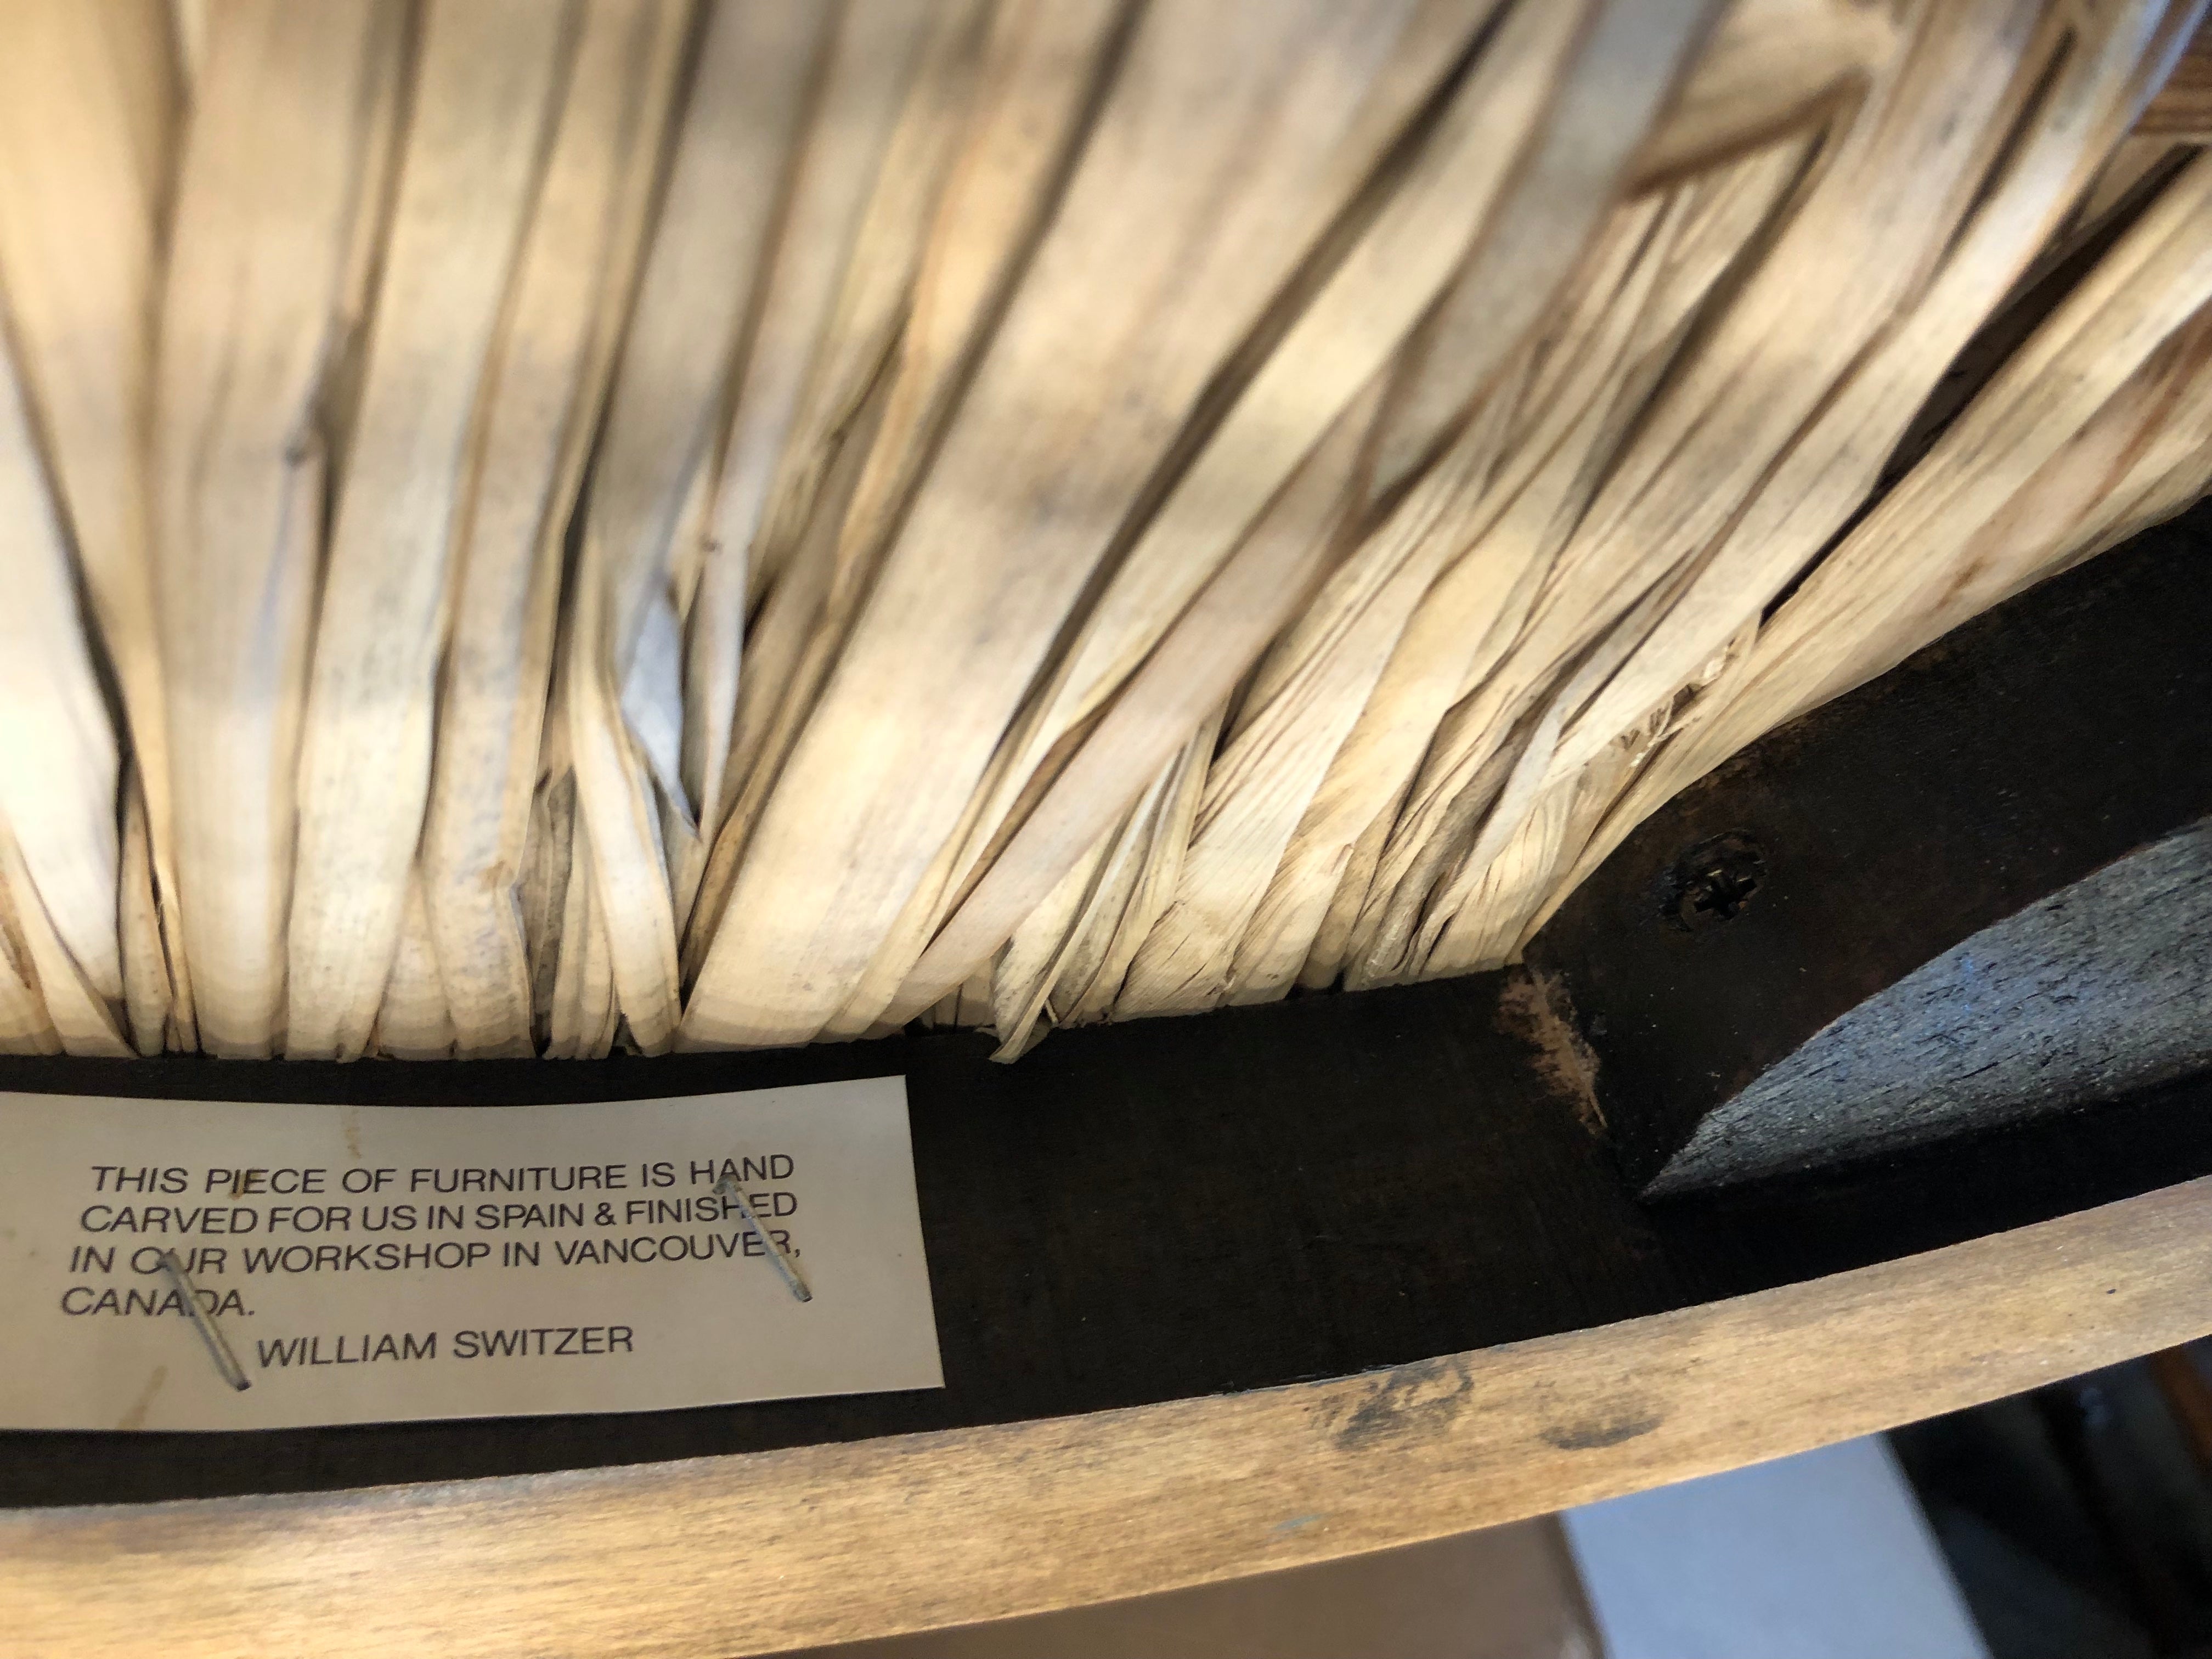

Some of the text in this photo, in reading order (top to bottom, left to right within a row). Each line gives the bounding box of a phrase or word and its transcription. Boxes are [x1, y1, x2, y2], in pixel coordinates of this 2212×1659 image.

[92, 1154, 794, 1194] THIS PIECE OF FURNITURE IS HAND
[81, 1205, 258, 1234] CARVED
[268, 1205, 350, 1233] FOR
[362, 1205, 417, 1231] US
[428, 1204, 464, 1230] IN
[475, 1203, 584, 1231] SPAIN
[595, 1202, 615, 1225] &
[69, 1245, 115, 1274] IN
[245, 1242, 490, 1273] WORKSHOP
[504, 1242, 540, 1266] IN
[555, 1229, 801, 1265] VANCOUVER,
[257, 1326, 634, 1368] WILLIAM SWITZER
